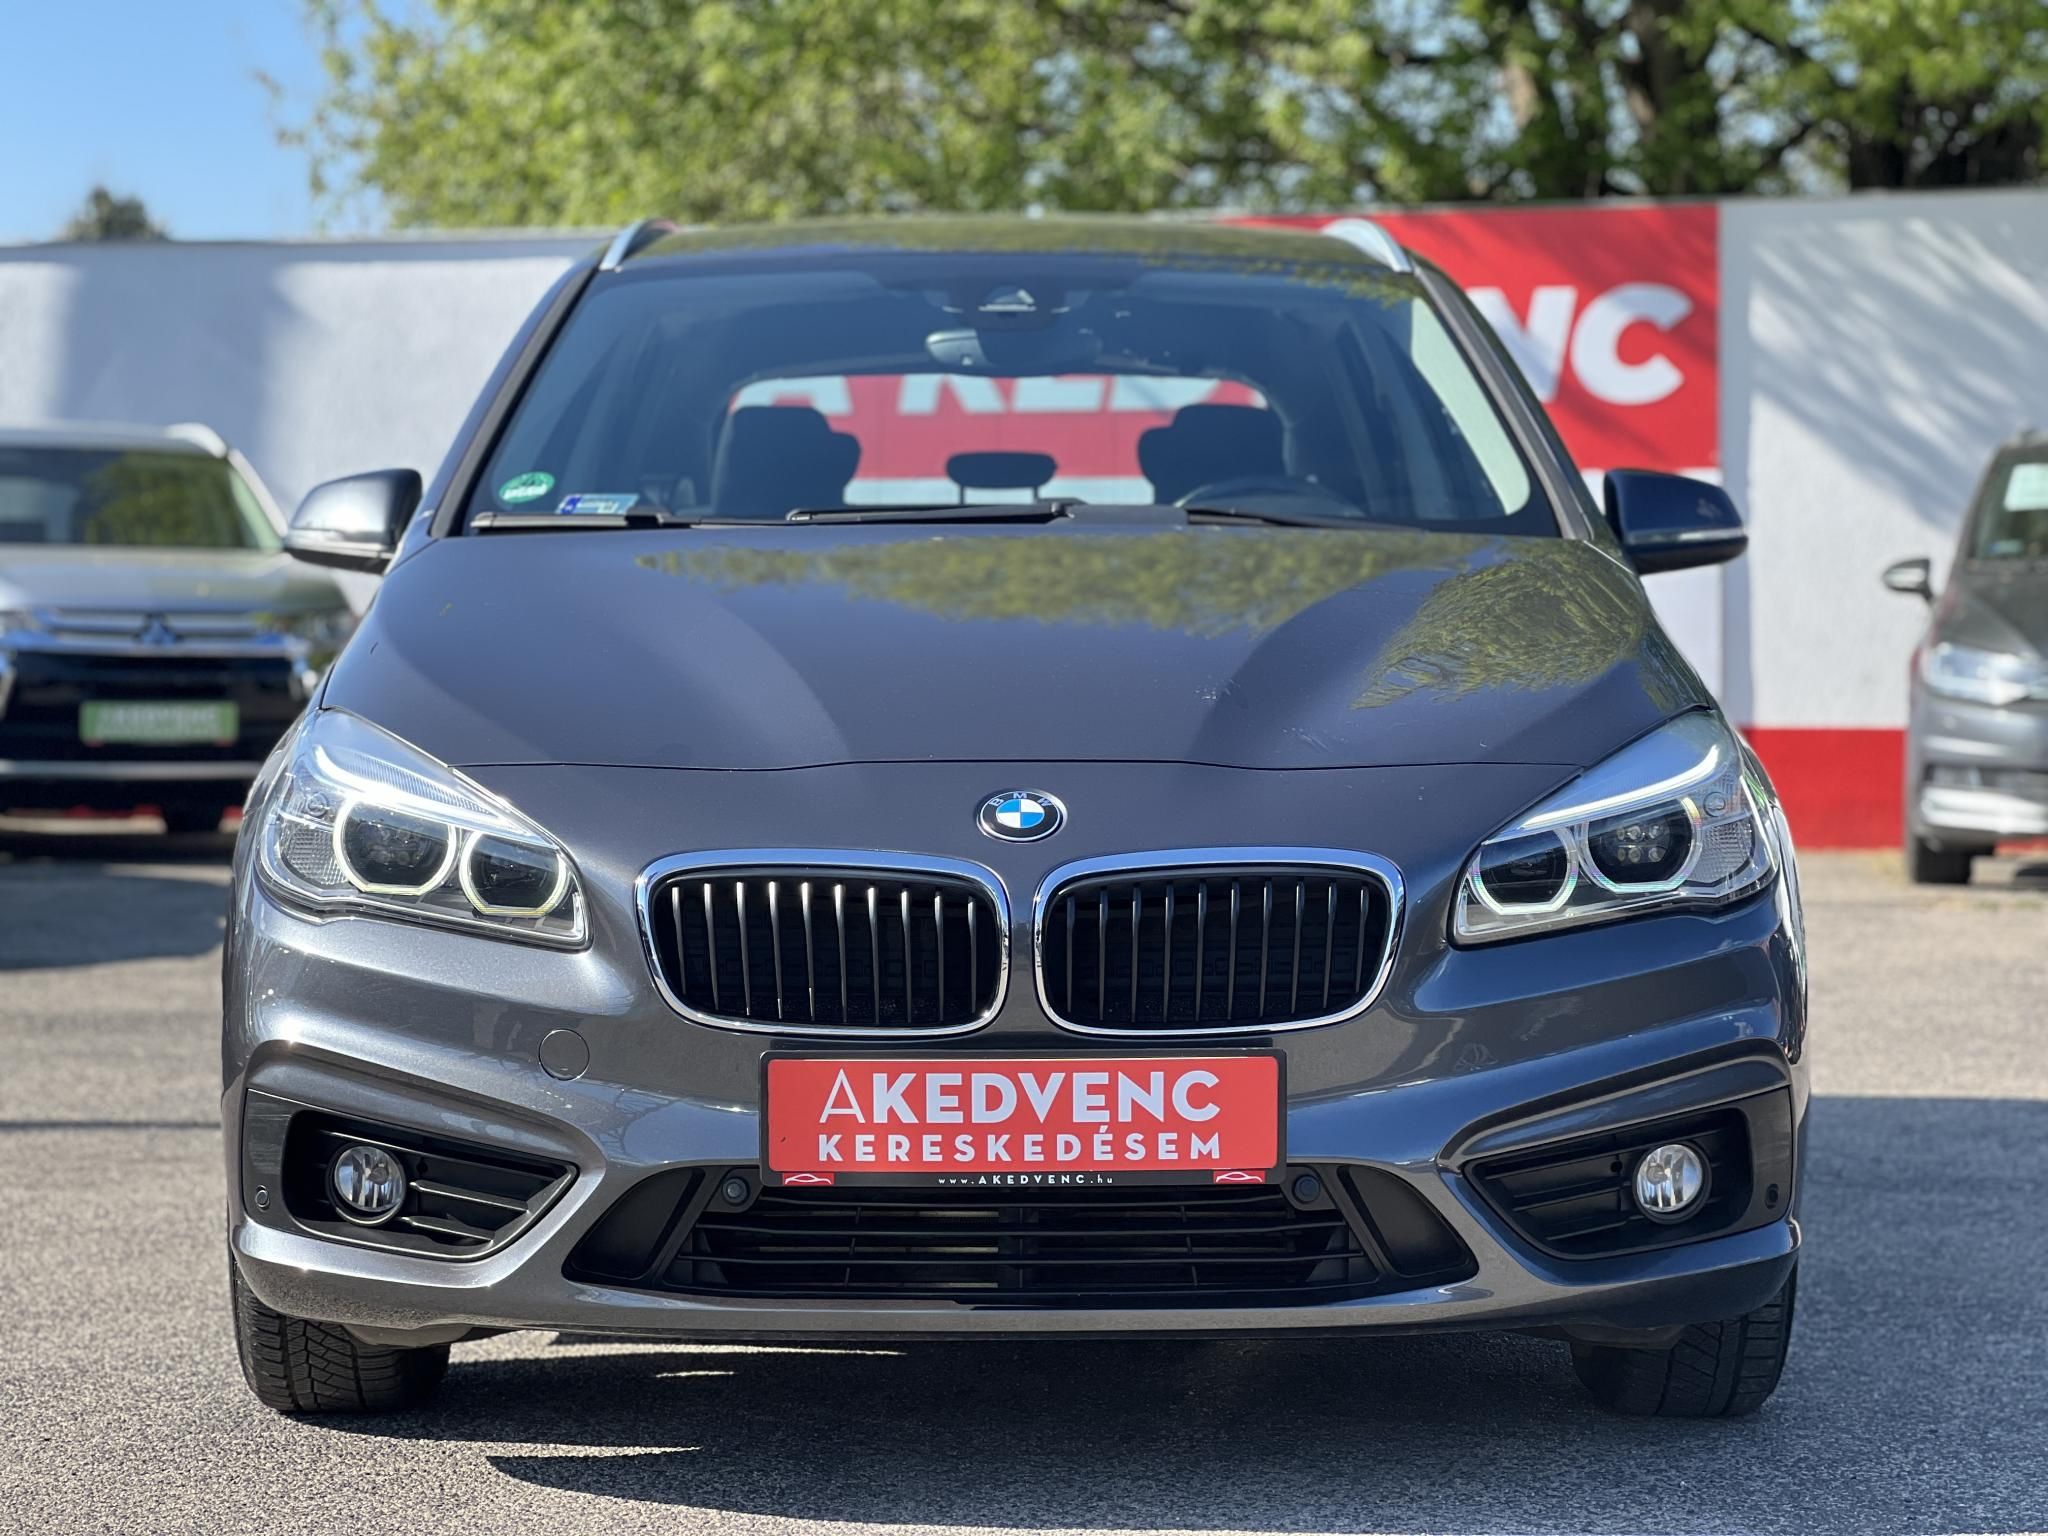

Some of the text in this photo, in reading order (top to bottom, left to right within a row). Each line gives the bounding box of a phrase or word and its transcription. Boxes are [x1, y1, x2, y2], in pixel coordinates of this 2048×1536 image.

[988, 791, 1053, 807] BMW
[818, 1126, 1221, 1162] KERESKEDÉSEM
[938, 1174, 1113, 1185] www.AKEDVENC.hu
